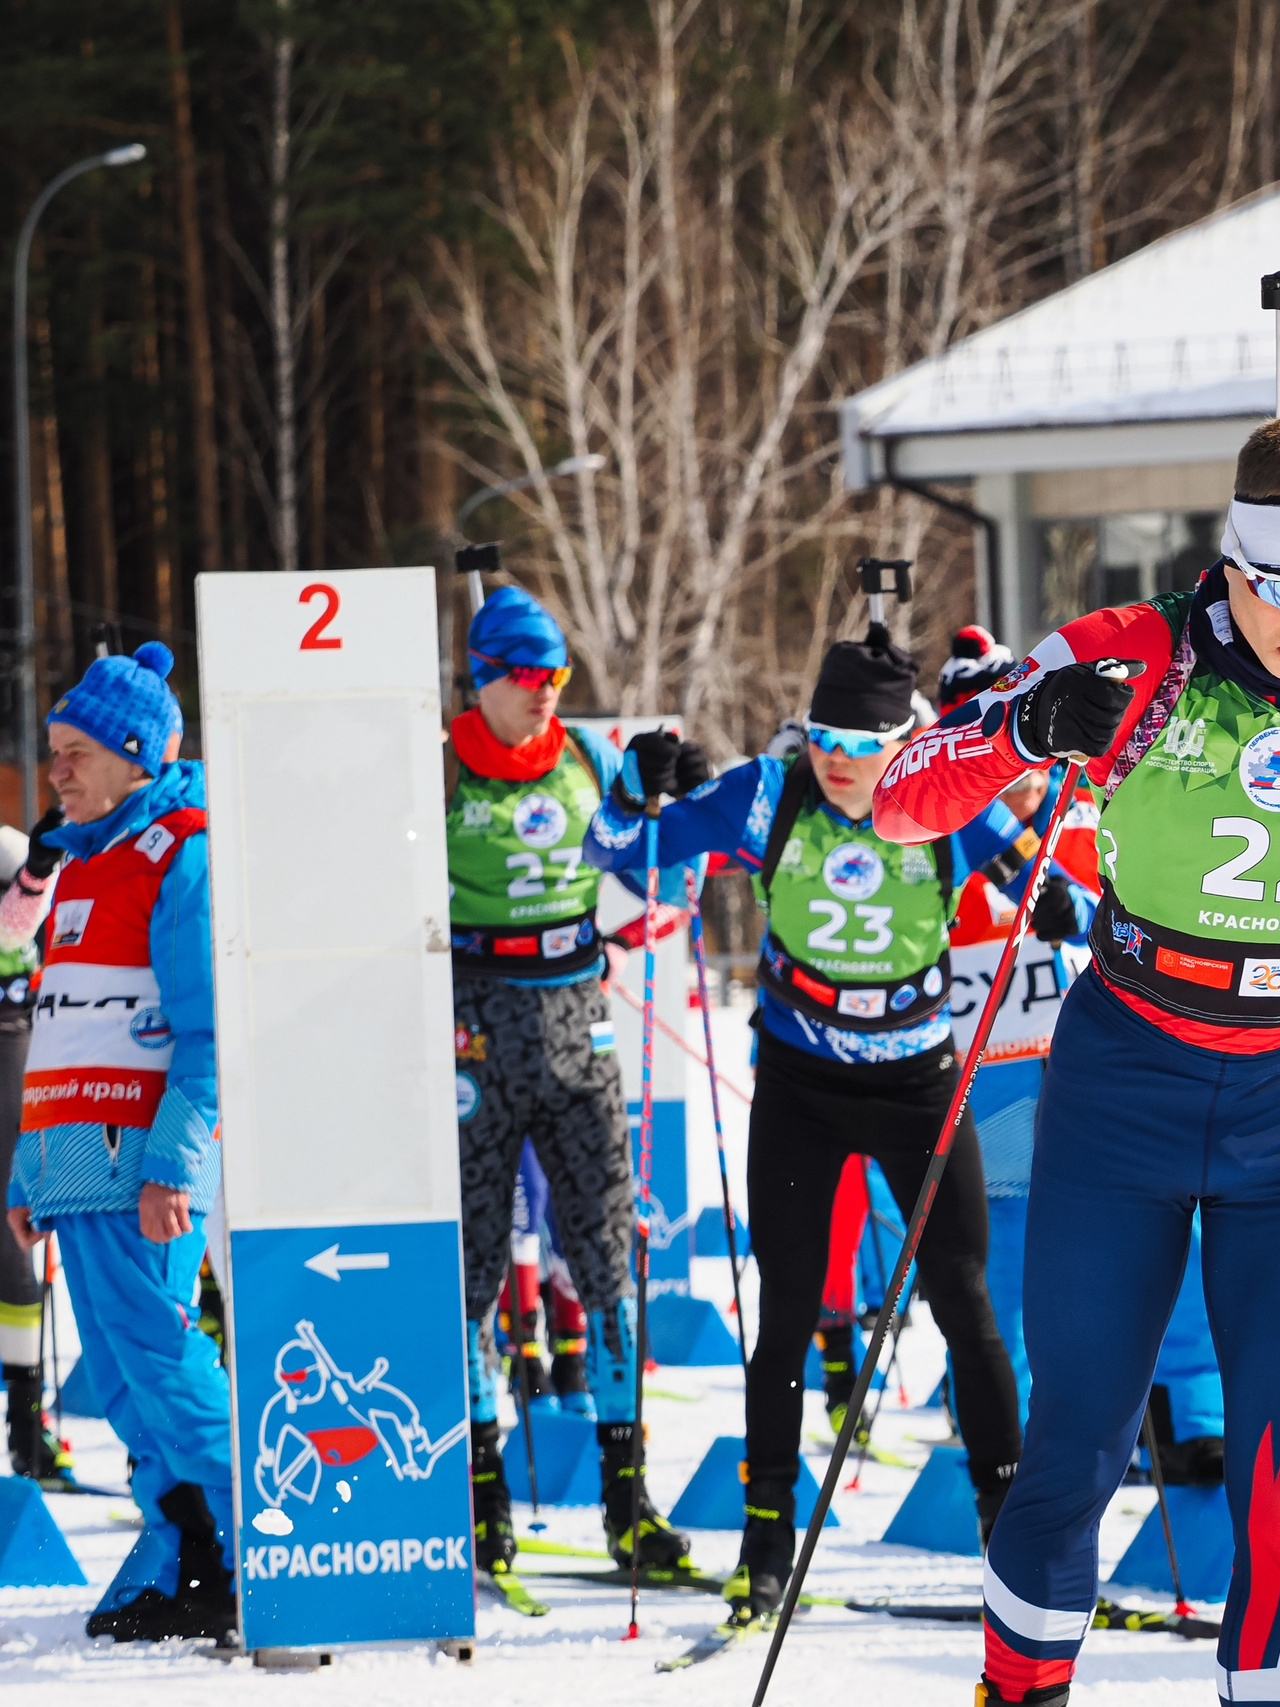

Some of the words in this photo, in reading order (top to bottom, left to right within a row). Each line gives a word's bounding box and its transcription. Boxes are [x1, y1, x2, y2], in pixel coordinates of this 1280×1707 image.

[298, 583, 344, 651] 2
[506, 846, 583, 899] 27
[807, 899, 894, 955] 23
[950, 959, 1061, 1017] СУД
[81, 1079, 142, 1102] край
[246, 1536, 469, 1581] КРАСНОЯРСК
